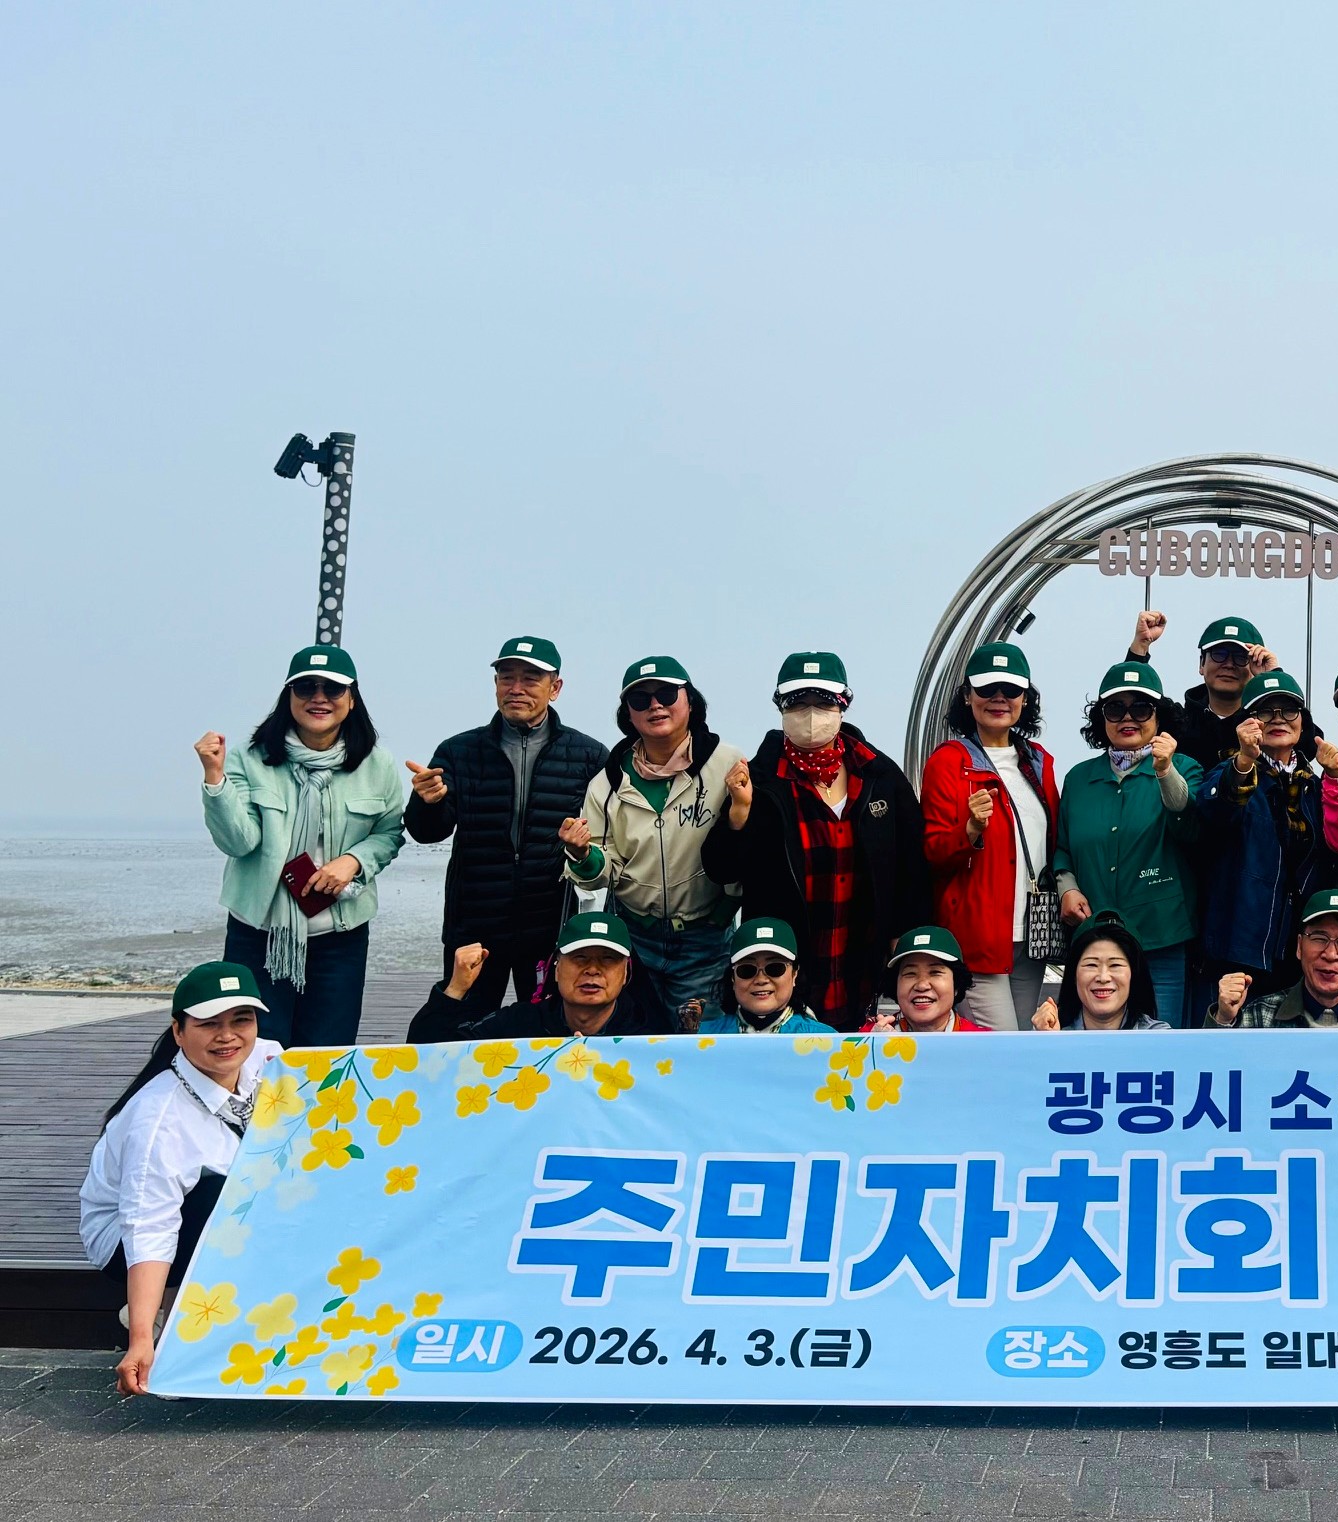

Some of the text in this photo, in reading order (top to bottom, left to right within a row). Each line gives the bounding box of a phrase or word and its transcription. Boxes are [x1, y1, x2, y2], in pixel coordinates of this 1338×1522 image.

[1045, 1069, 1242, 1135] 광명시
[510, 1149, 1325, 1307] 주민자치회
[410, 1321, 872, 1370] 일시 2026. 4. 3.(금)
[1002, 1326, 1090, 1370] 장소
[1118, 1330, 1247, 1371] 영흥도
